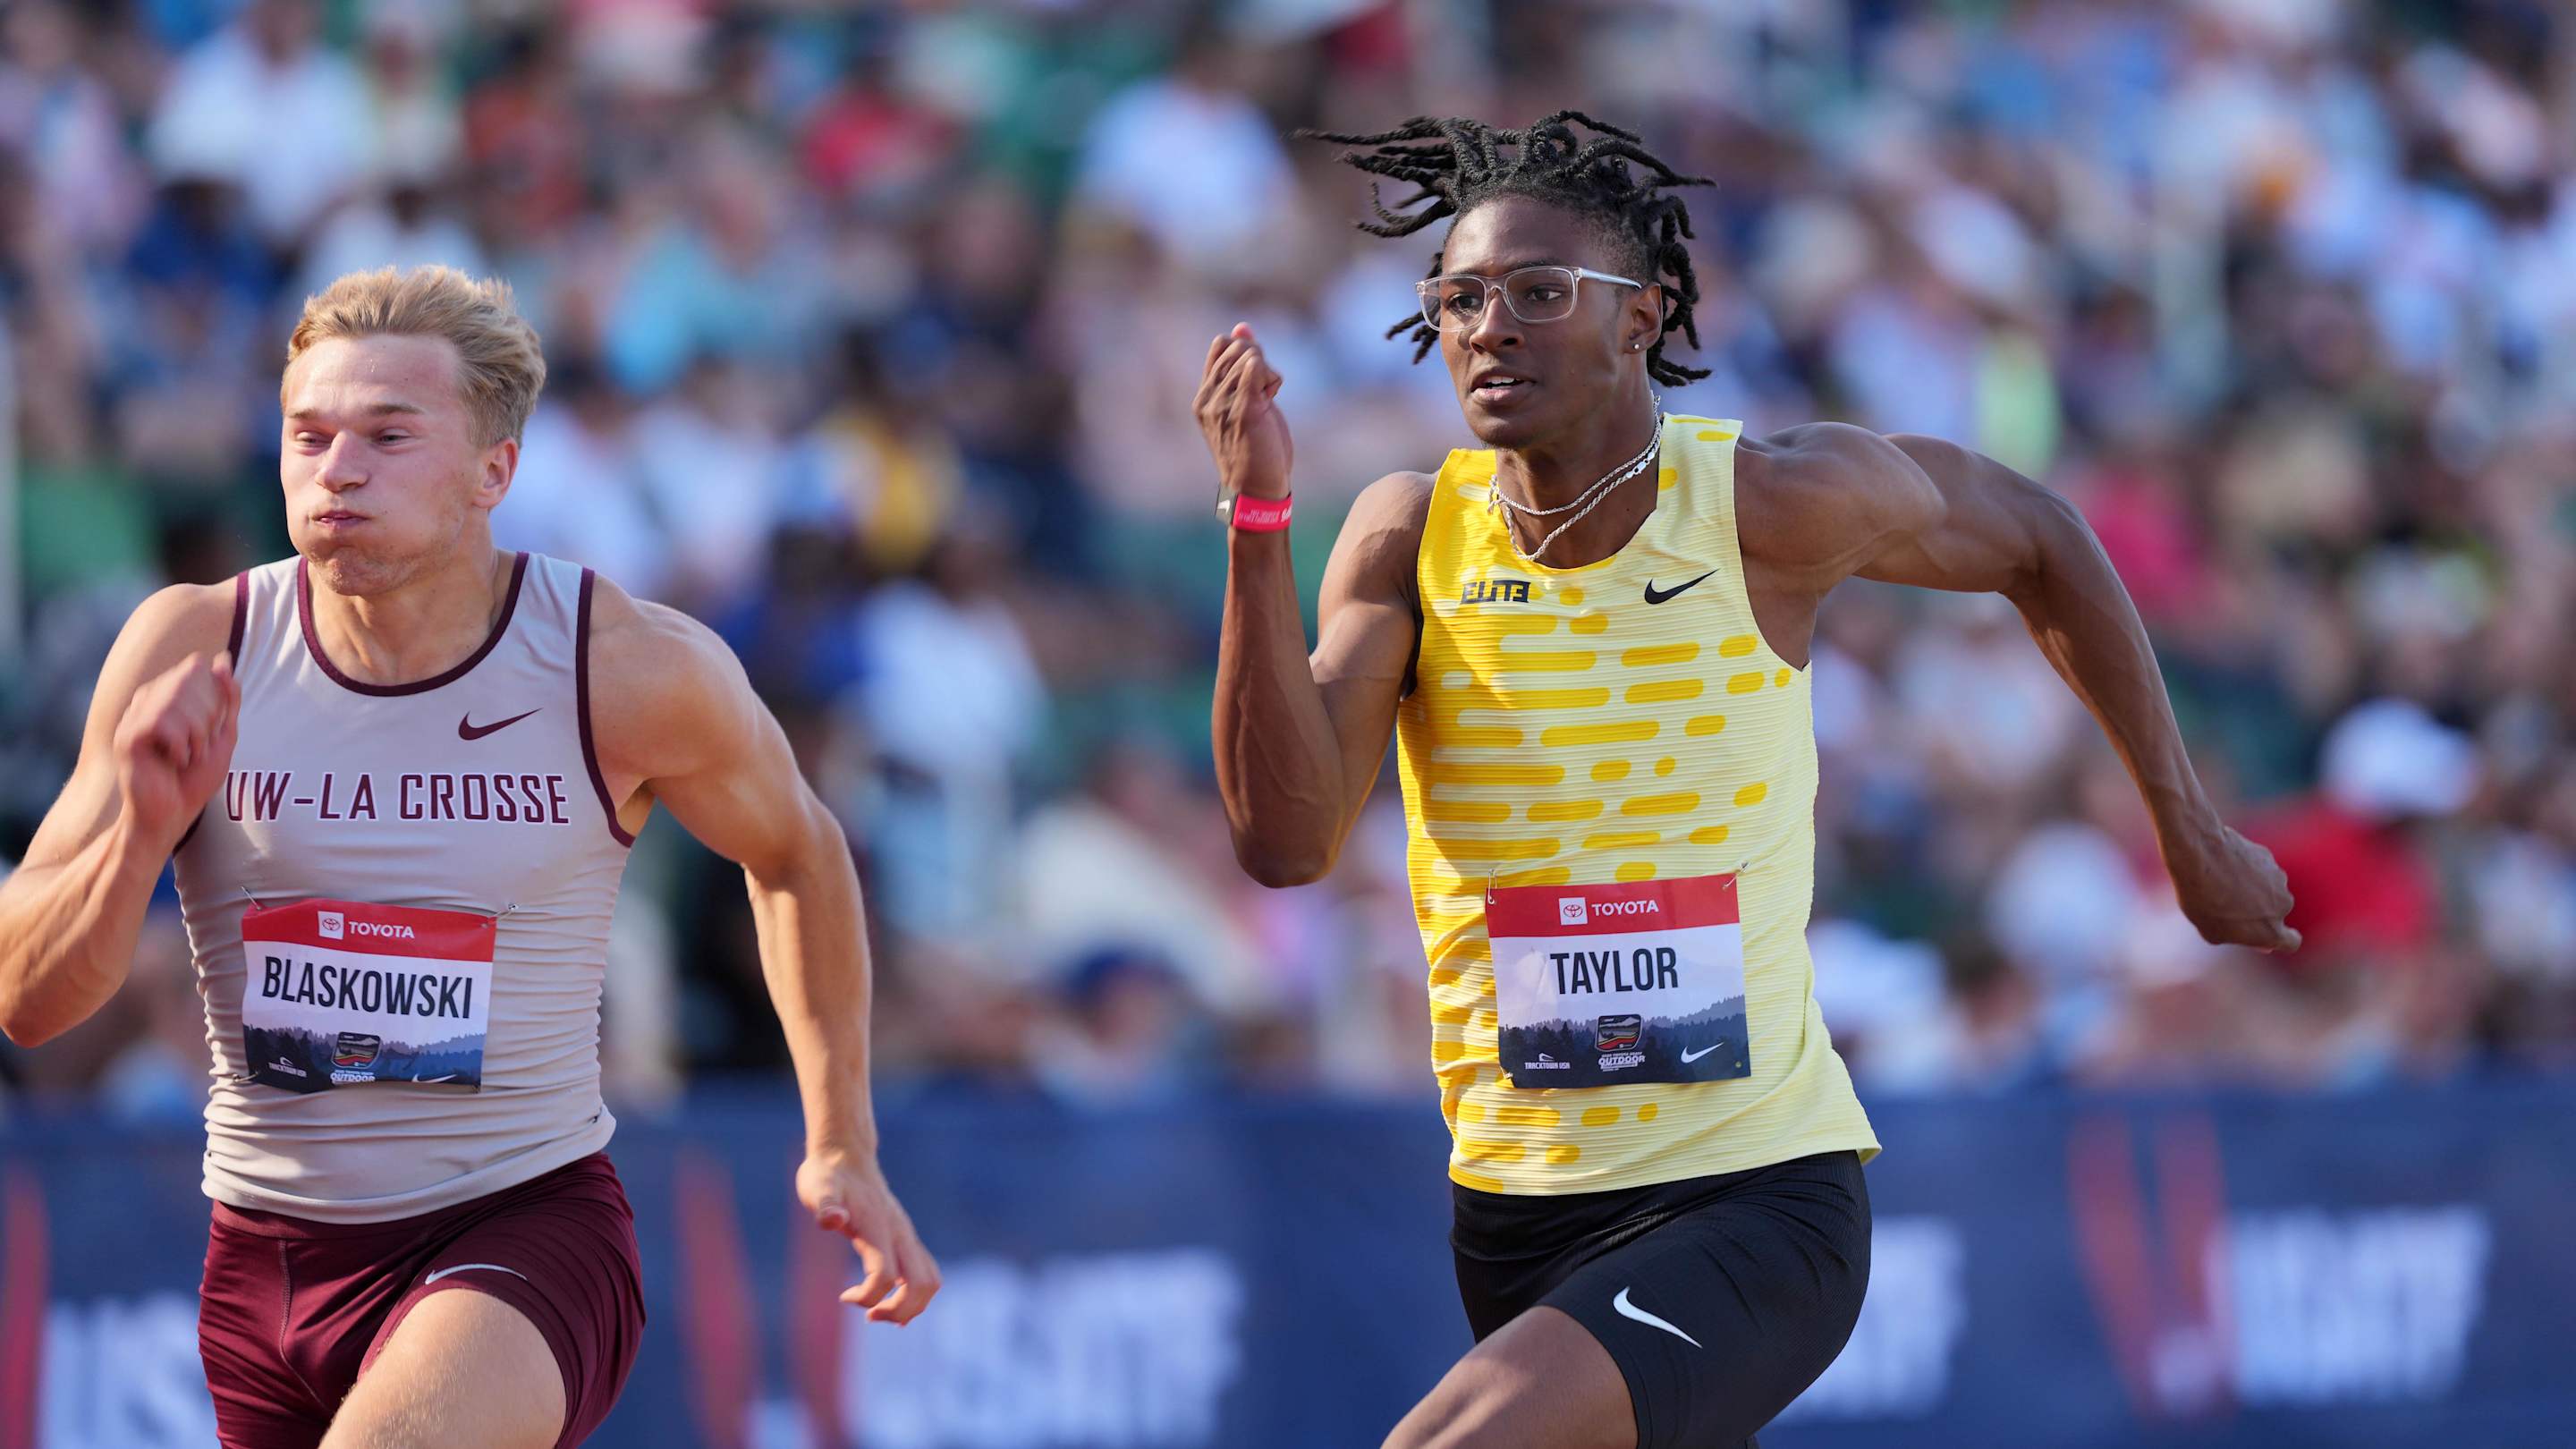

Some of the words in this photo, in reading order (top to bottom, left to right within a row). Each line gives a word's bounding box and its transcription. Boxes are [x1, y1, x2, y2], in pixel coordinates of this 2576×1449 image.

[1460, 580, 1531, 605] ELITE
[225, 769, 377, 821] UW-LA
[399, 772, 571, 826] CROSSE
[1591, 899, 1659, 917] TOYOTA
[348, 920, 415, 939] TOYOTA
[1550, 946, 1679, 996] TAYLOR
[262, 955, 473, 1020] BLASKOWSKI
[1598, 1055, 1646, 1067] OUTDOOR
[330, 1072, 376, 1082] OUTDOOR
